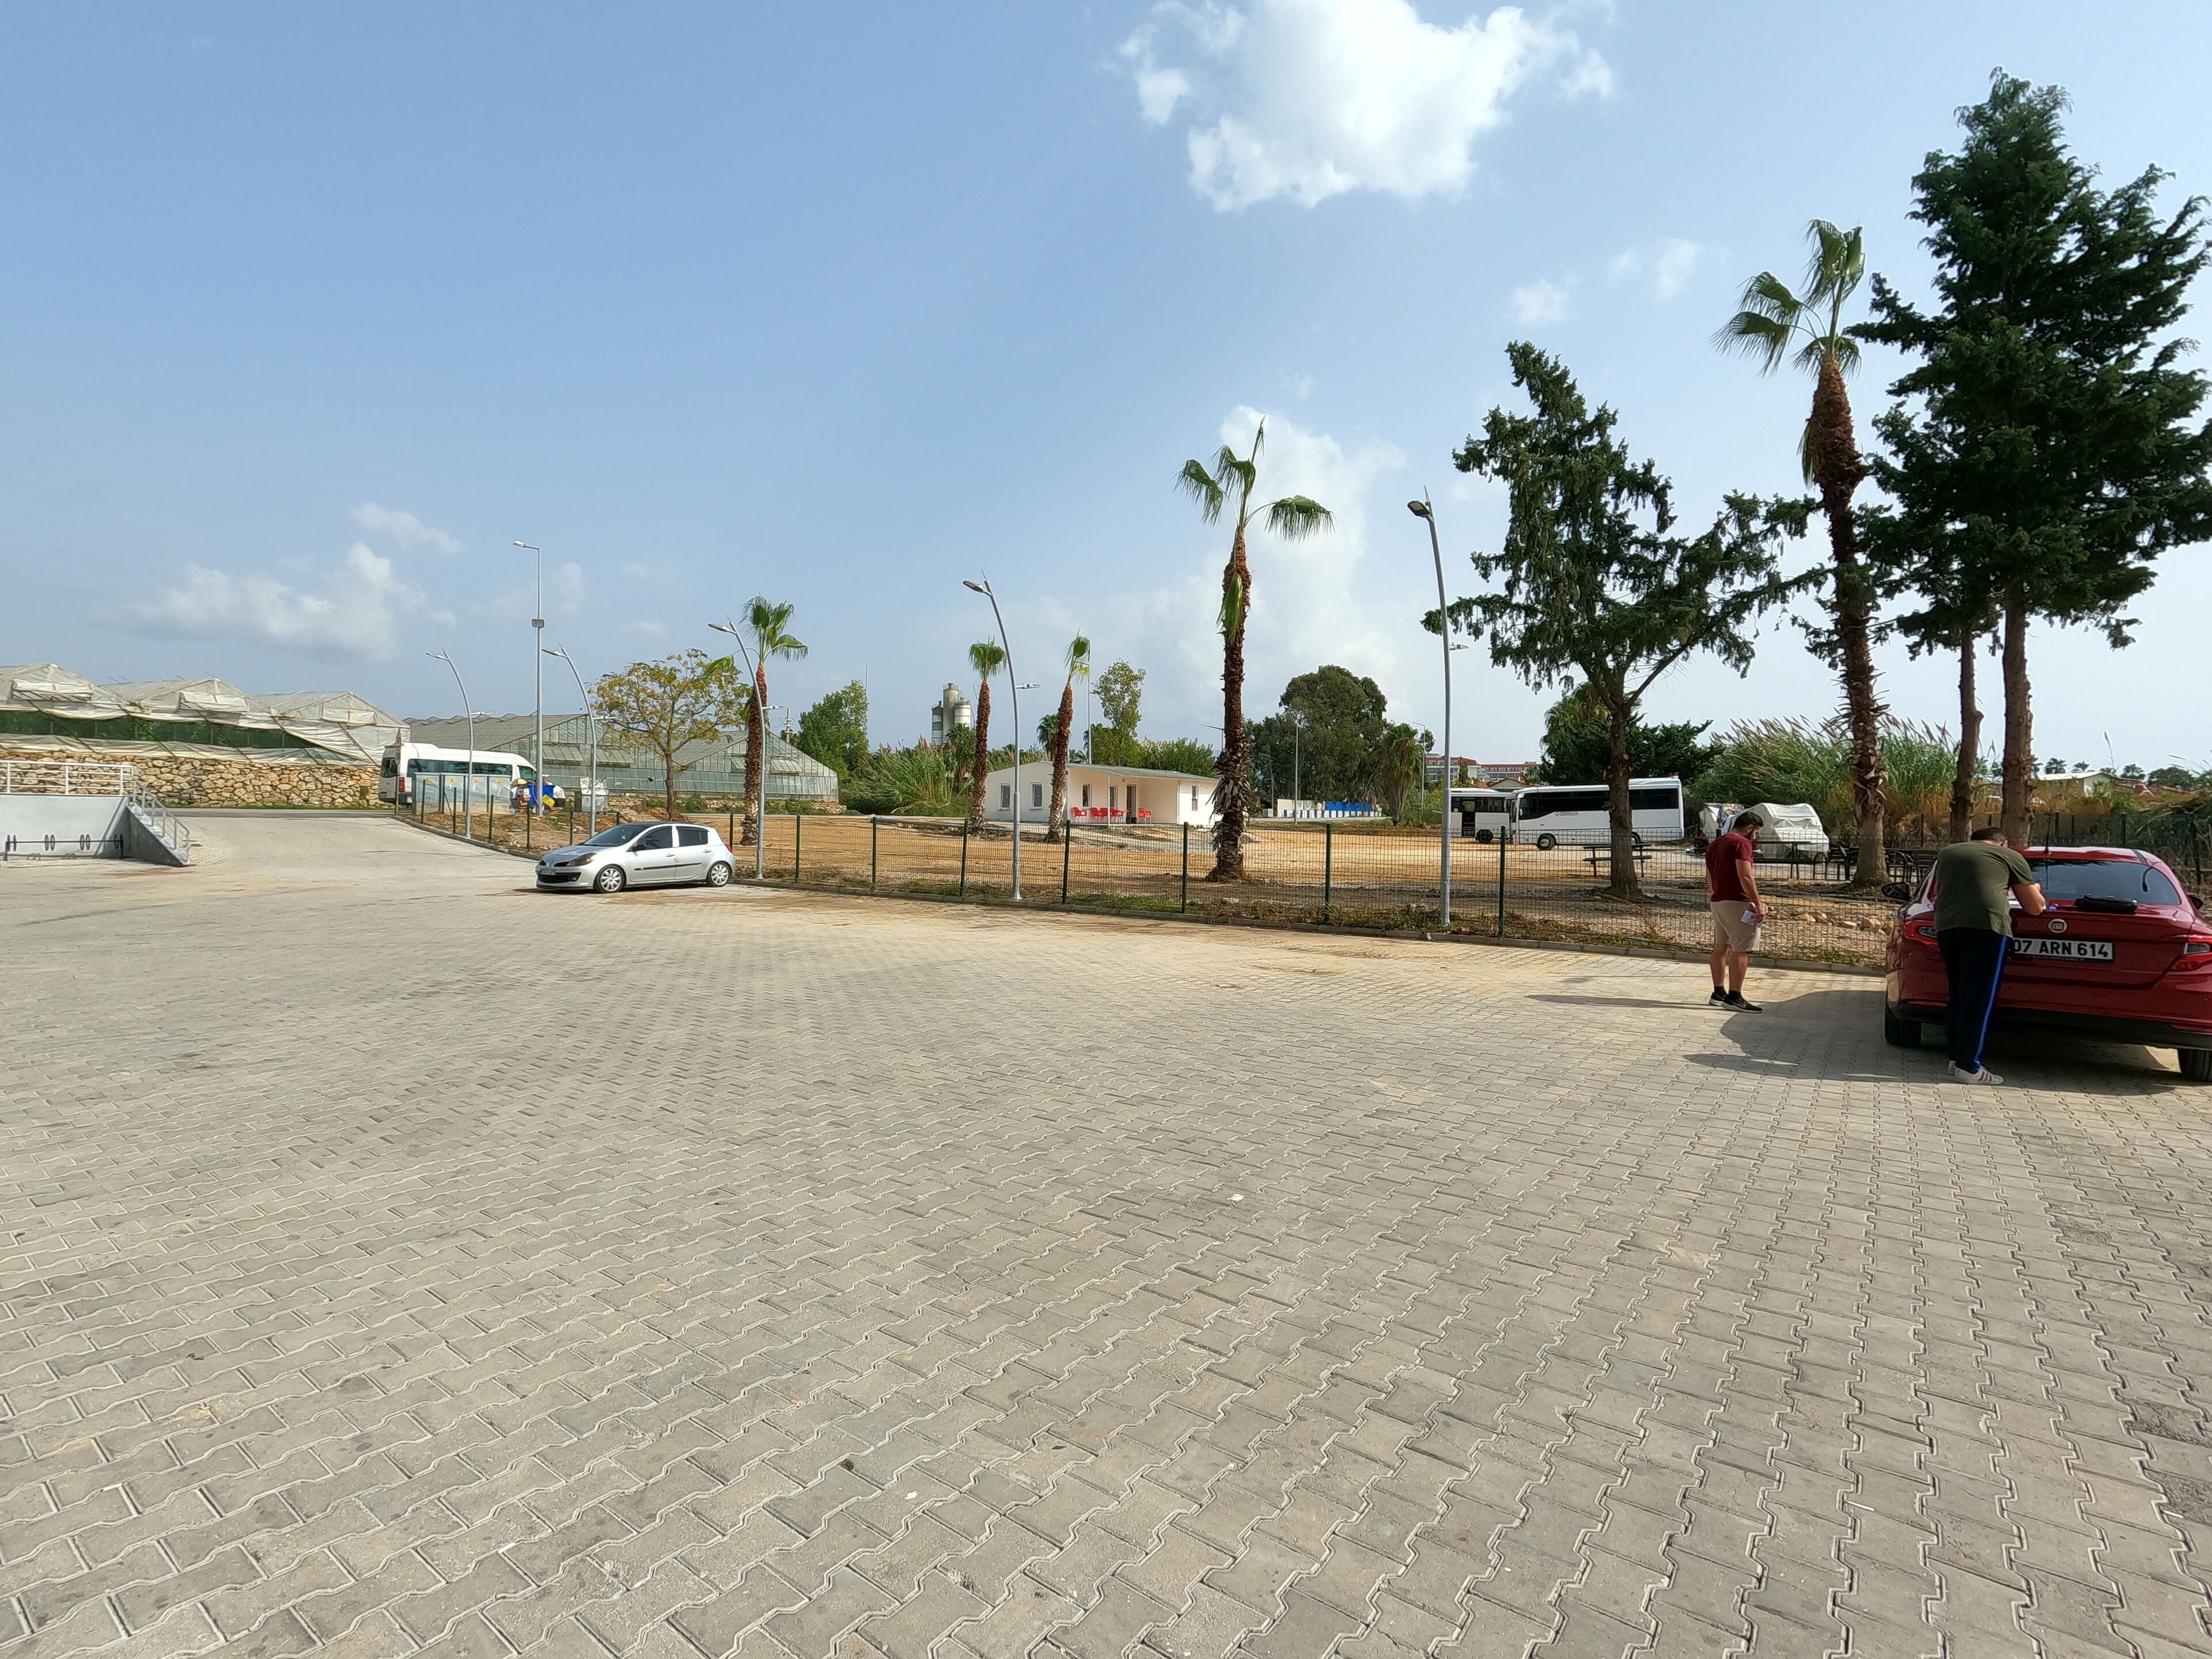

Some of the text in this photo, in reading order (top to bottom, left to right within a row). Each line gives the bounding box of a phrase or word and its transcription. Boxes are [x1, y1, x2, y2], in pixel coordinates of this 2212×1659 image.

[2013, 940, 2109, 957] 07 ARN 614
